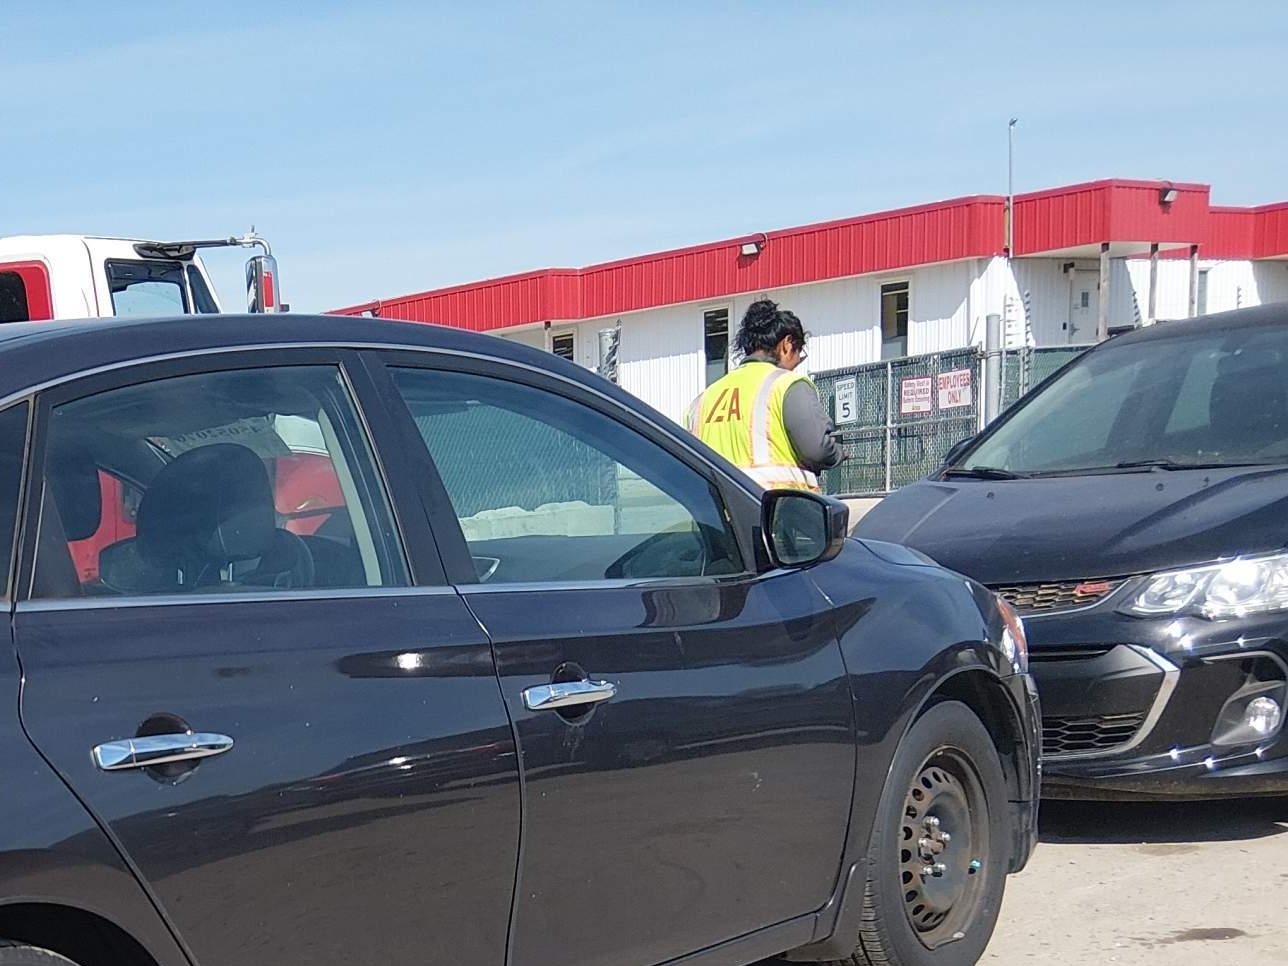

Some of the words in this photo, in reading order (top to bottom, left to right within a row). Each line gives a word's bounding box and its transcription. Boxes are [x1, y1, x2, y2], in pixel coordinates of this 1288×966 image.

[836, 382, 855, 391] SPEED
[938, 373, 970, 390] EMPLOYEES
[838, 391, 854, 401] LIMIT
[903, 387, 930, 397] REQUIRED
[947, 390, 962, 405] ONLY
[841, 401, 851, 418] 5
